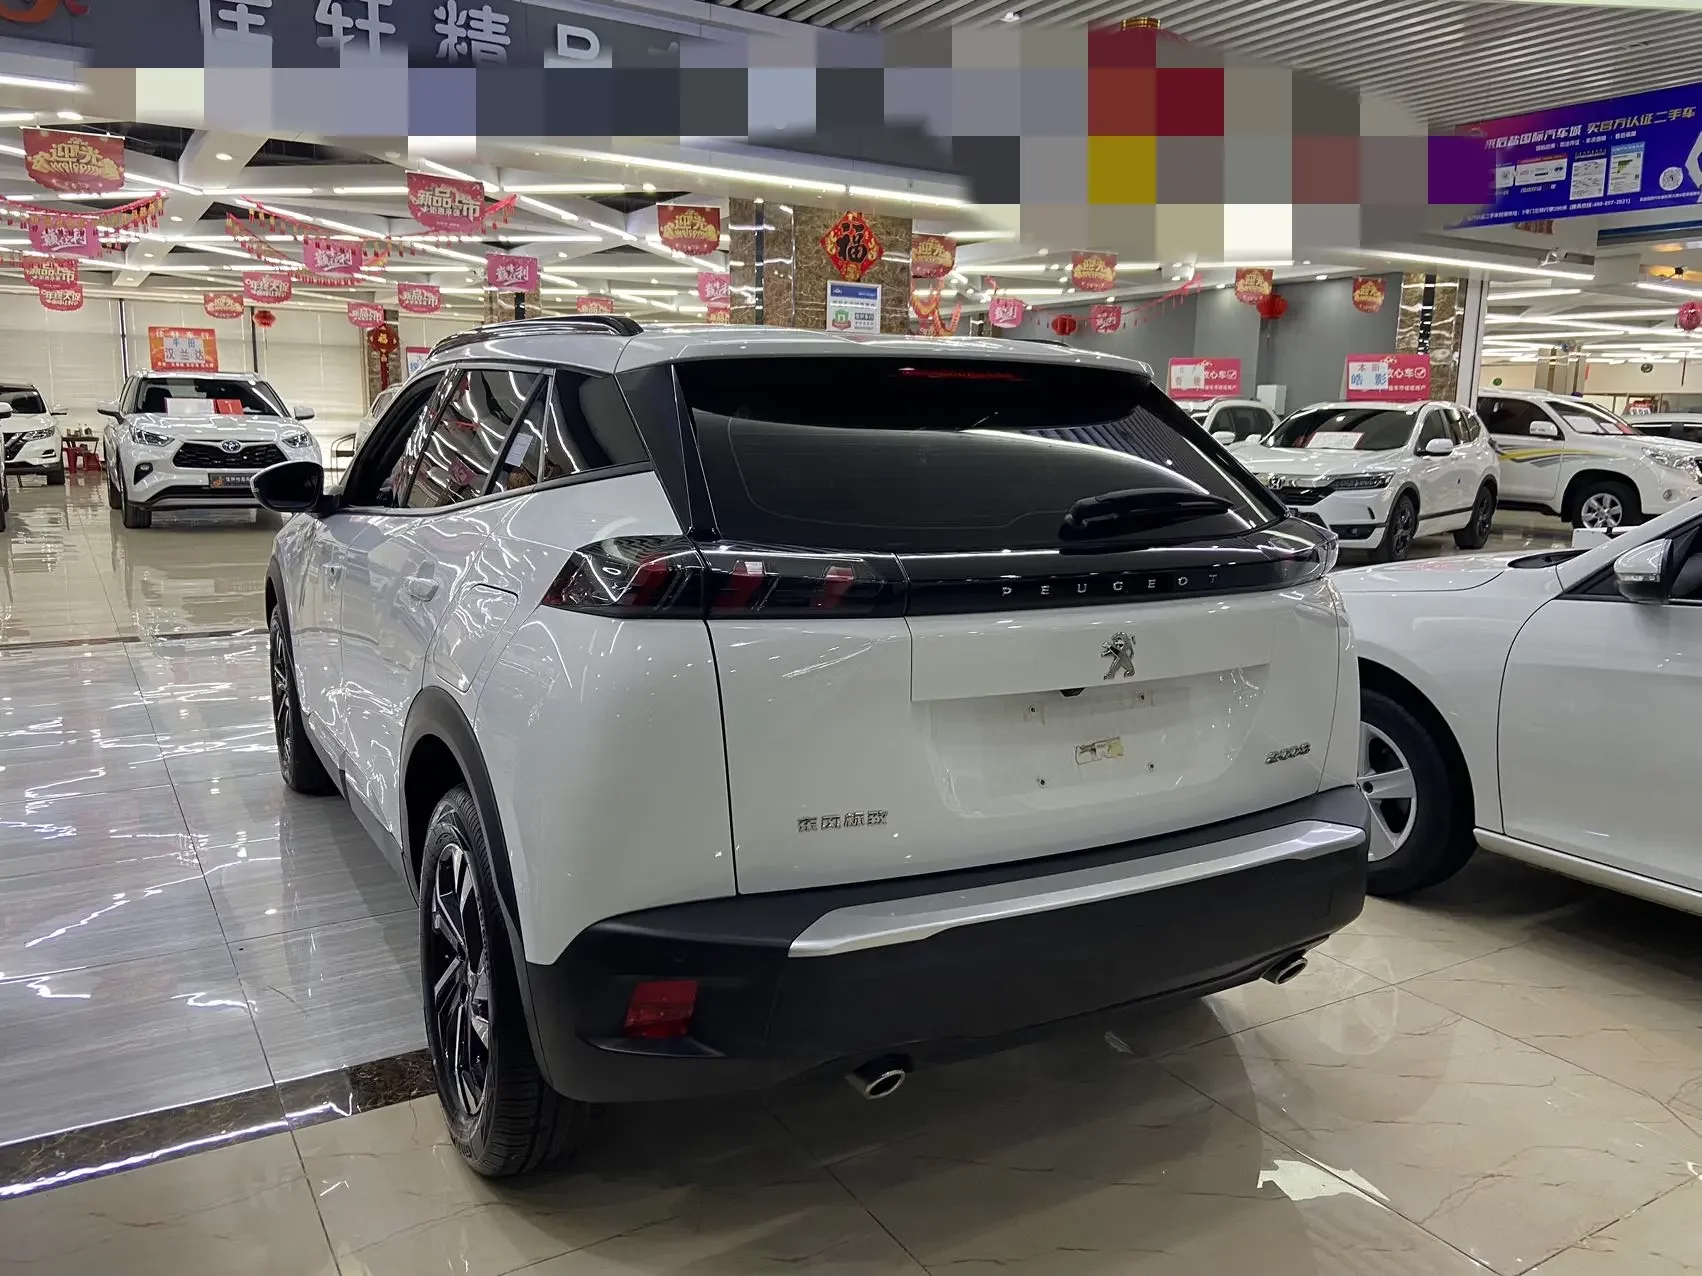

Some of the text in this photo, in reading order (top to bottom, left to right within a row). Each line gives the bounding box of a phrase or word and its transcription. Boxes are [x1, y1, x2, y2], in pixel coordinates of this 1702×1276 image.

[197, 0, 603, 67] 佳轩精
[836, 222, 868, 263] 福
[165, 347, 204, 361] 汉兰达
[1351, 373, 1387, 385] 皓影
[1001, 574, 1218, 597] PEUGEOT
[1264, 742, 1311, 765] 2008
[798, 810, 888, 832] 东风标致
